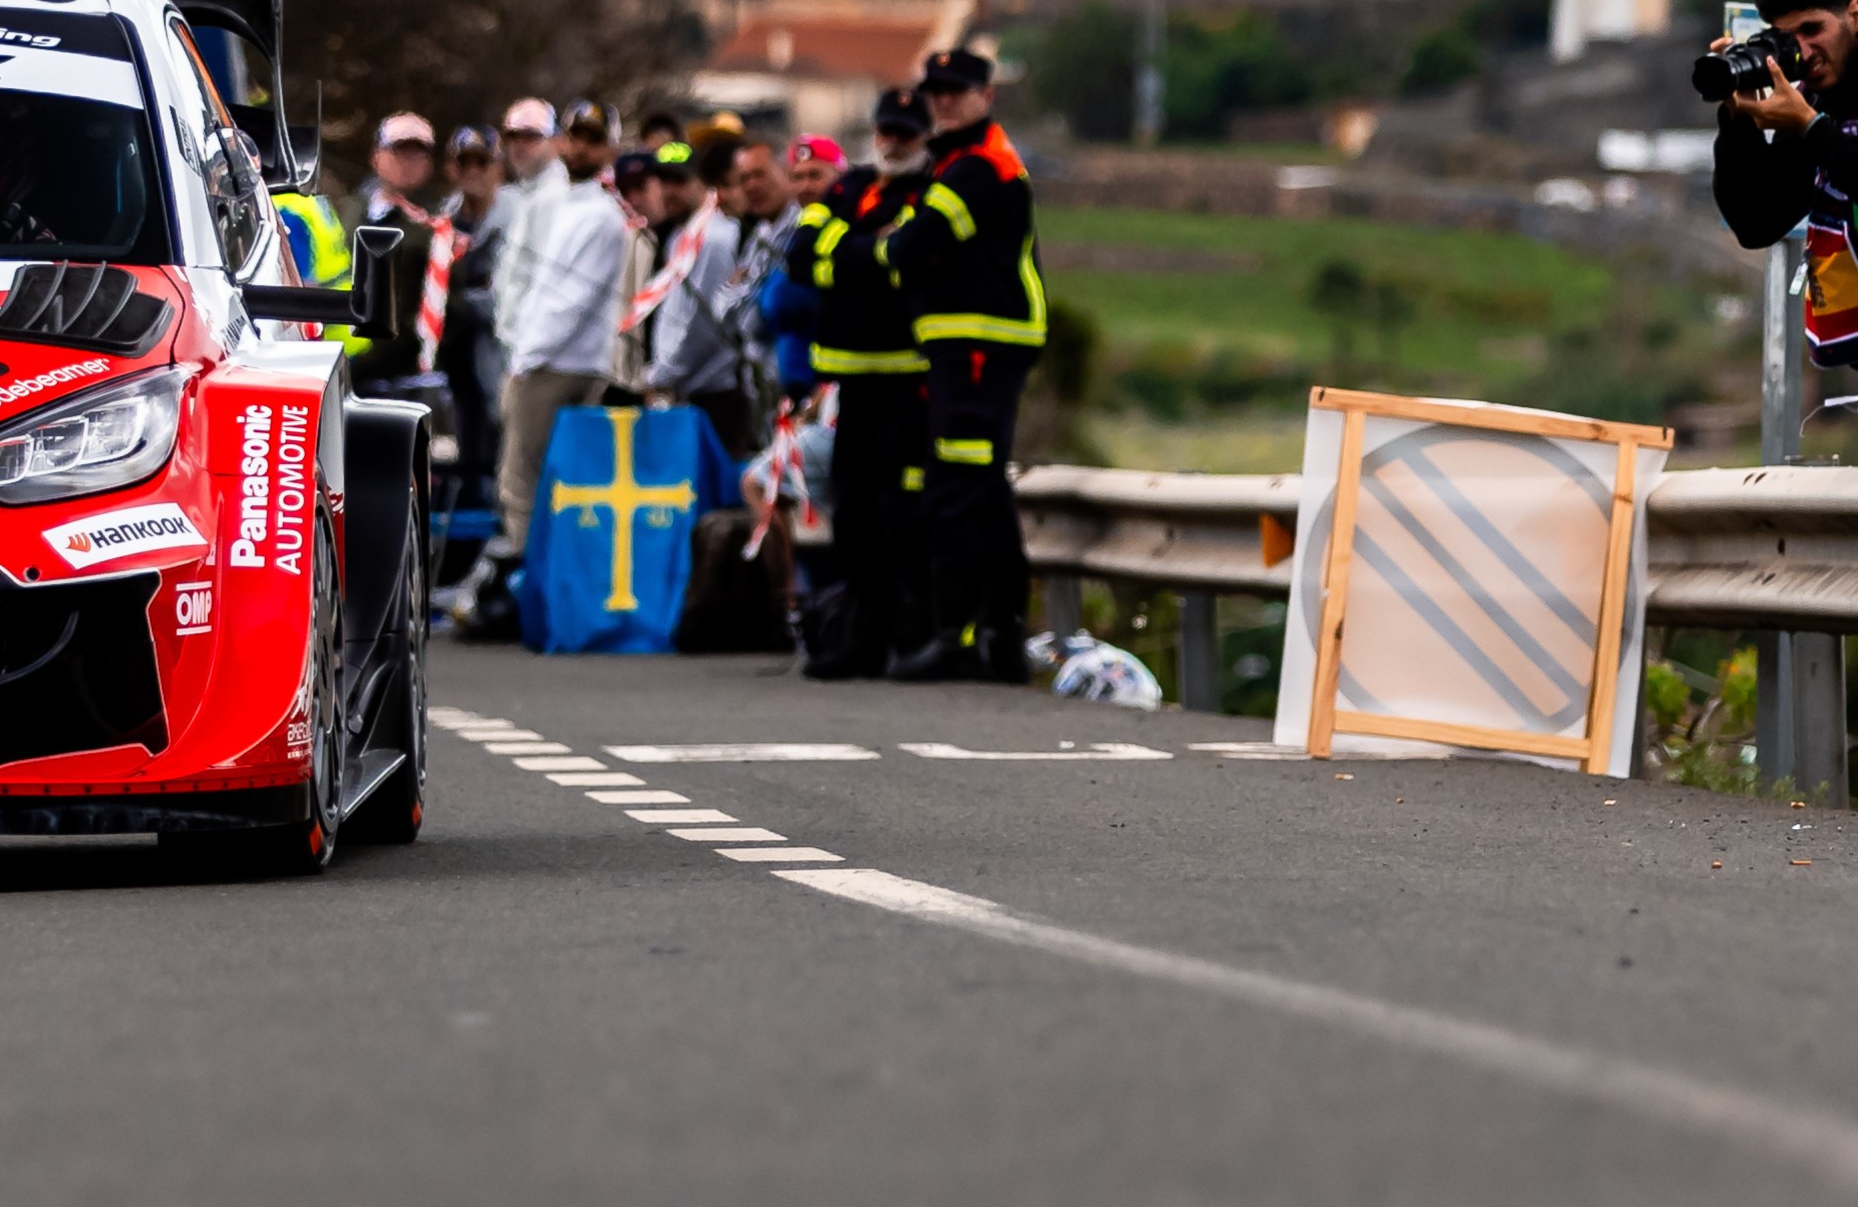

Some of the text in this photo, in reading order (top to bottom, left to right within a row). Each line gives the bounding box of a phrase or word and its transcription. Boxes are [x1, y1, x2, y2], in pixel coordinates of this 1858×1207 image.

[230, 404, 273, 568] Panasonic
[275, 404, 309, 575] AUTOMOTIVE
[176, 590, 213, 626] OMP
